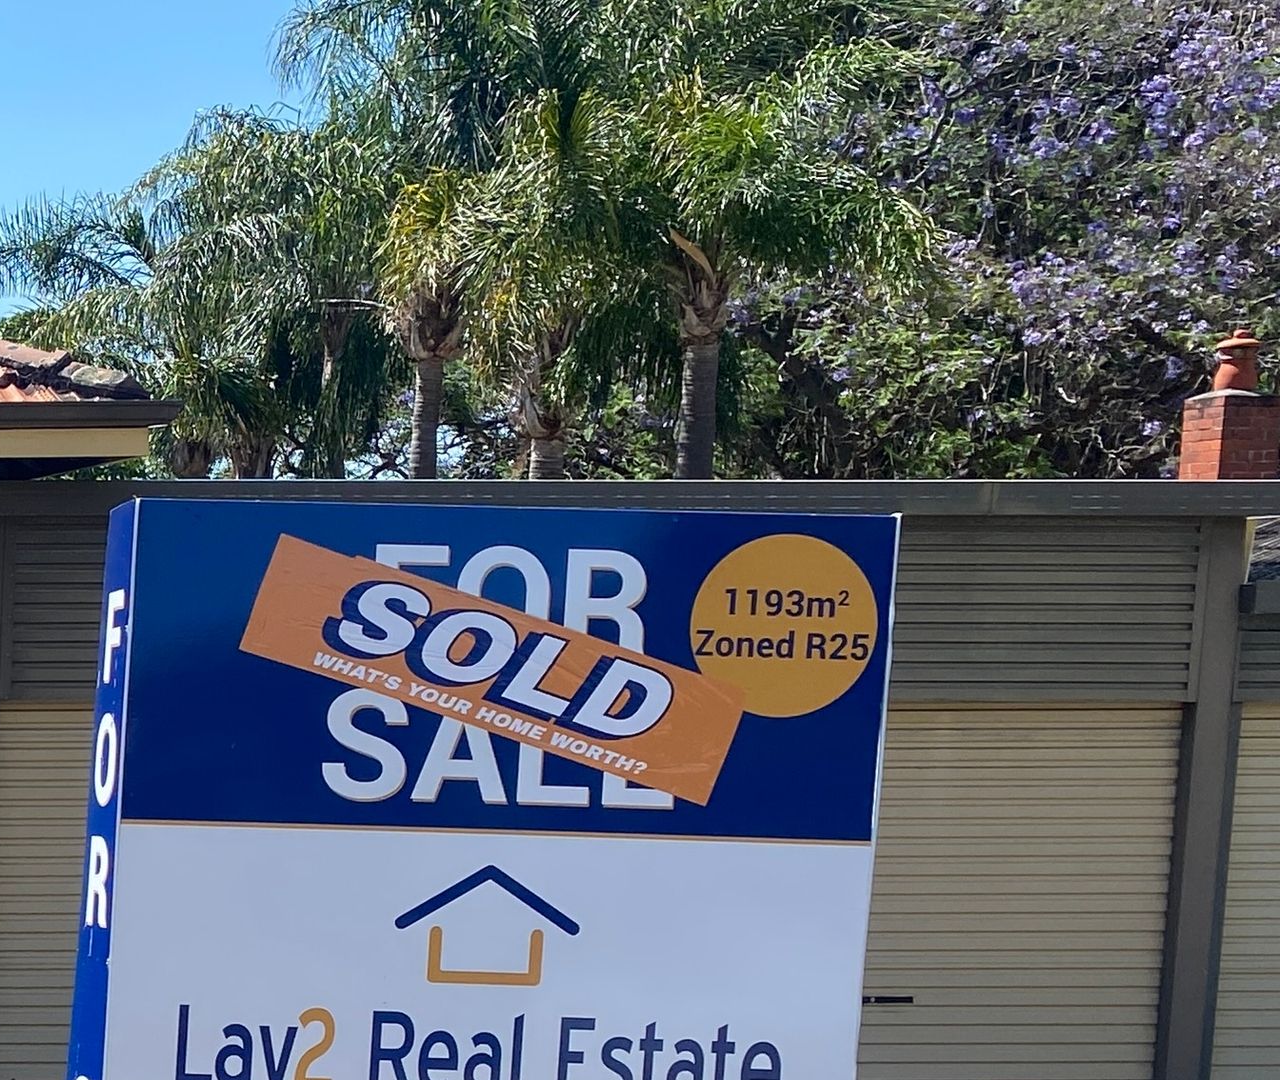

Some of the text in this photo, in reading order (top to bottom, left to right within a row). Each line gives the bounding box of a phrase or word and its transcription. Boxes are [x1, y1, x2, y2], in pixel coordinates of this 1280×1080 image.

[322, 580, 675, 740] SOLD
[695, 629, 873, 664] Zoned R25
[84, 588, 126, 930] FOR
[408, 682, 470, 717] YOUR
[479, 705, 547, 740] HOME
[550, 731, 648, 775] WORTH?
